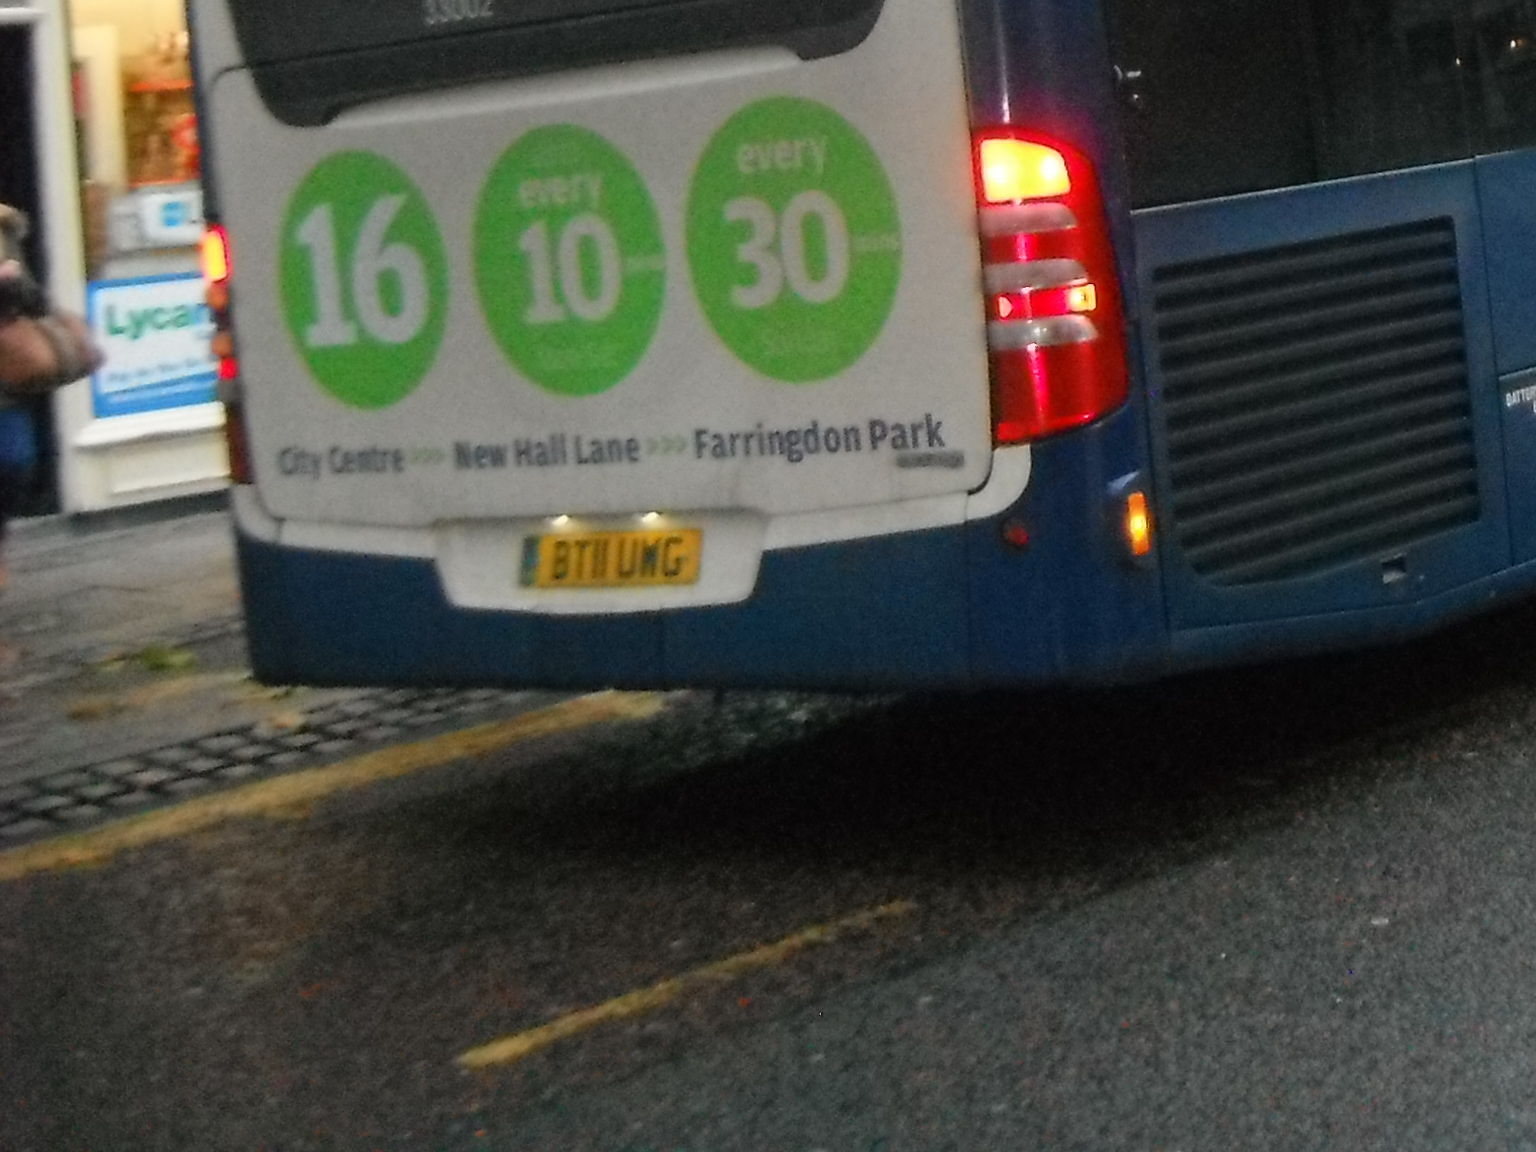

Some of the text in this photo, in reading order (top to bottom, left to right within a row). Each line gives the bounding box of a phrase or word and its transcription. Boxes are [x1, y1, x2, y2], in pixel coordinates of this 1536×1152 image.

[519, 173, 605, 212] every
[738, 134, 829, 176] every
[296, 193, 434, 347] 16
[519, 213, 623, 325] 10
[723, 189, 850, 309] 30
[279, 446, 322, 481] City
[327, 445, 405, 475] Centre
[453, 440, 507, 470] New
[513, 432, 566, 467] Hall
[574, 433, 640, 467] Lane
[694, 419, 862, 464] Farringdon
[868, 412, 945, 451] Park
